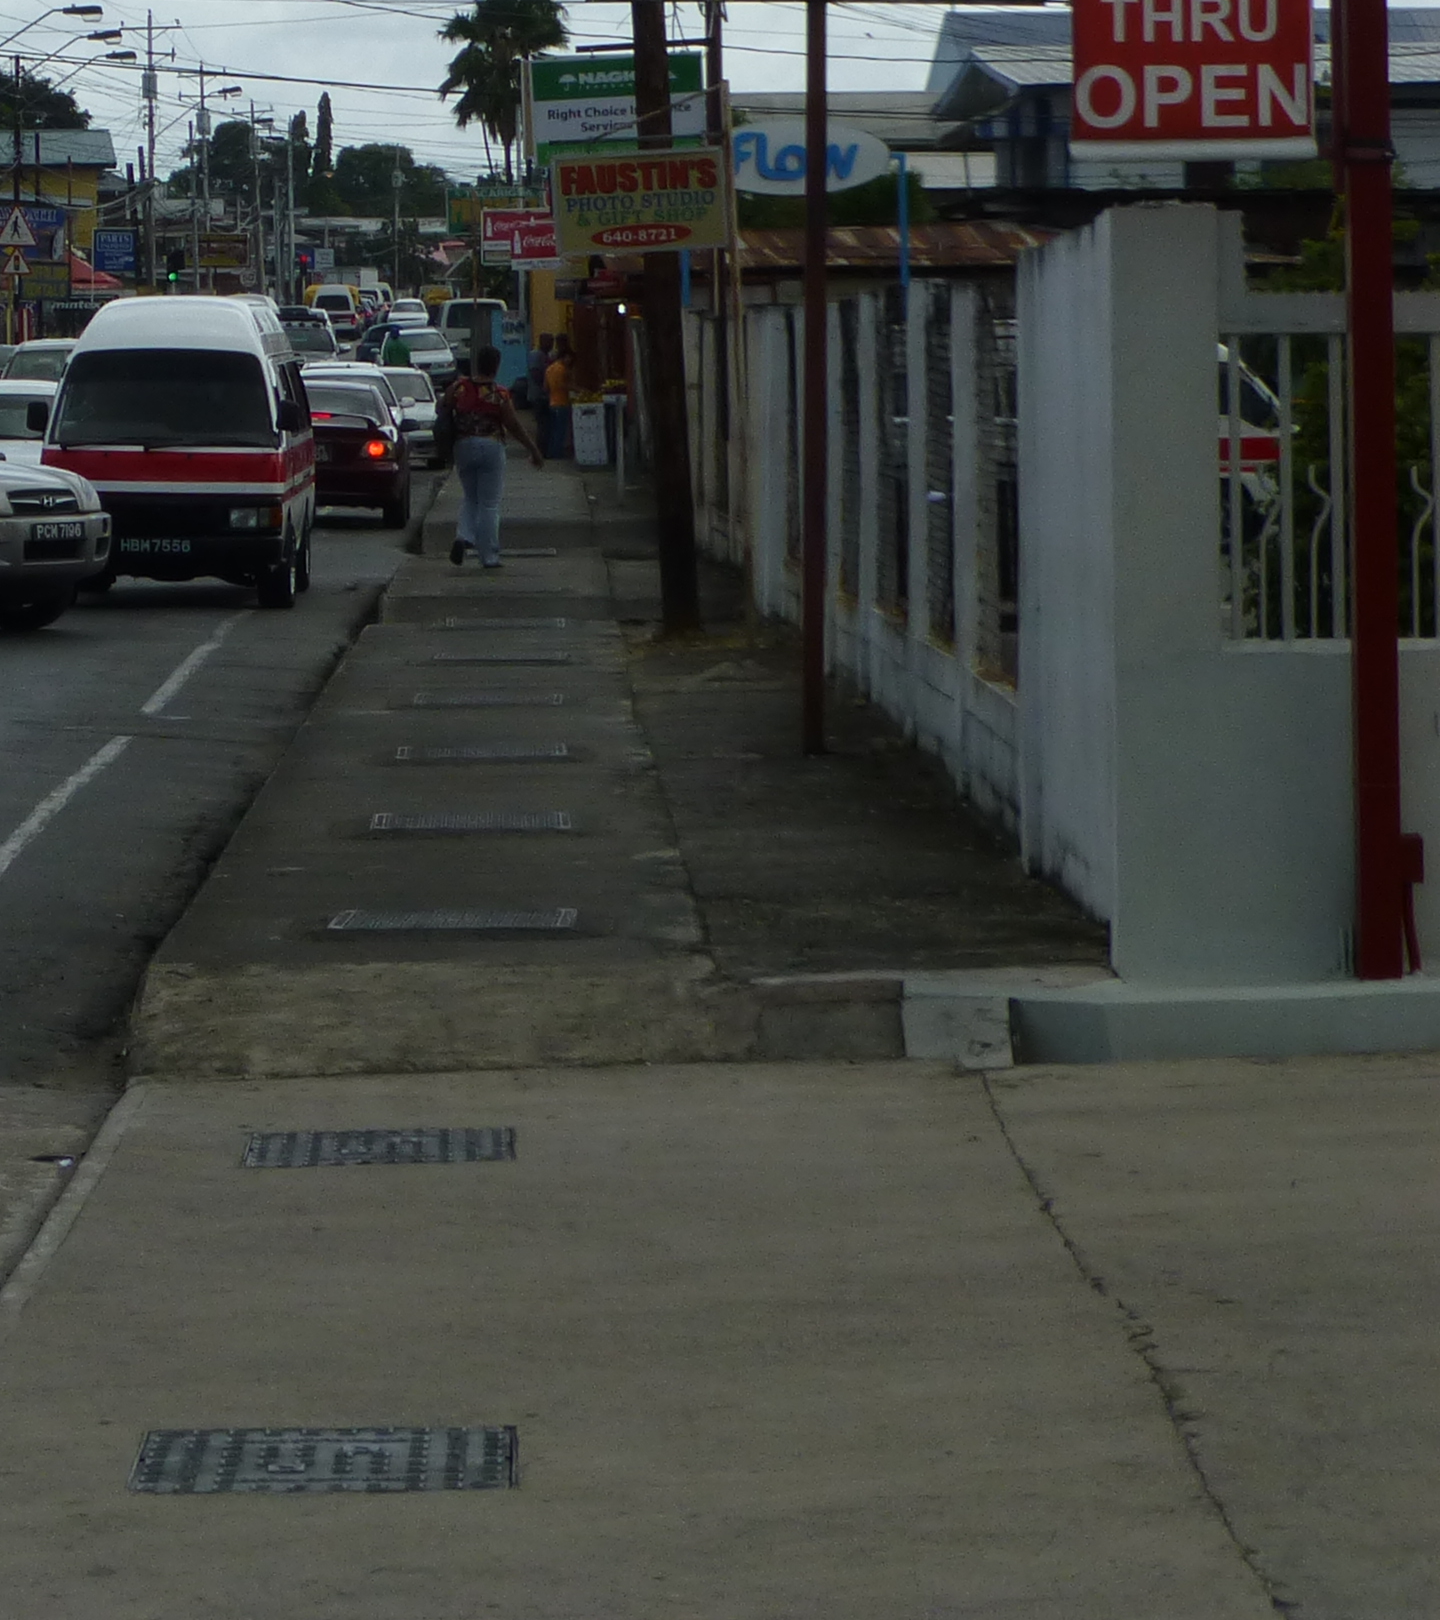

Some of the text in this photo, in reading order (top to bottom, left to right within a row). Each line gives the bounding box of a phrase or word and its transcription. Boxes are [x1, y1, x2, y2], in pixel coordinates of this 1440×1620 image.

[1075, 62, 1311, 131] OPEN
[548, 107, 582, 121] Right
[585, 105, 627, 118] Choice
[560, 158, 717, 196] FAUSTIN'S
[567, 190, 716, 214] PHOTO STUDIO
[598, 209, 645, 226] GIFT
[653, 207, 708, 223] SHOP
[602, 227, 678, 244] 640-8721
